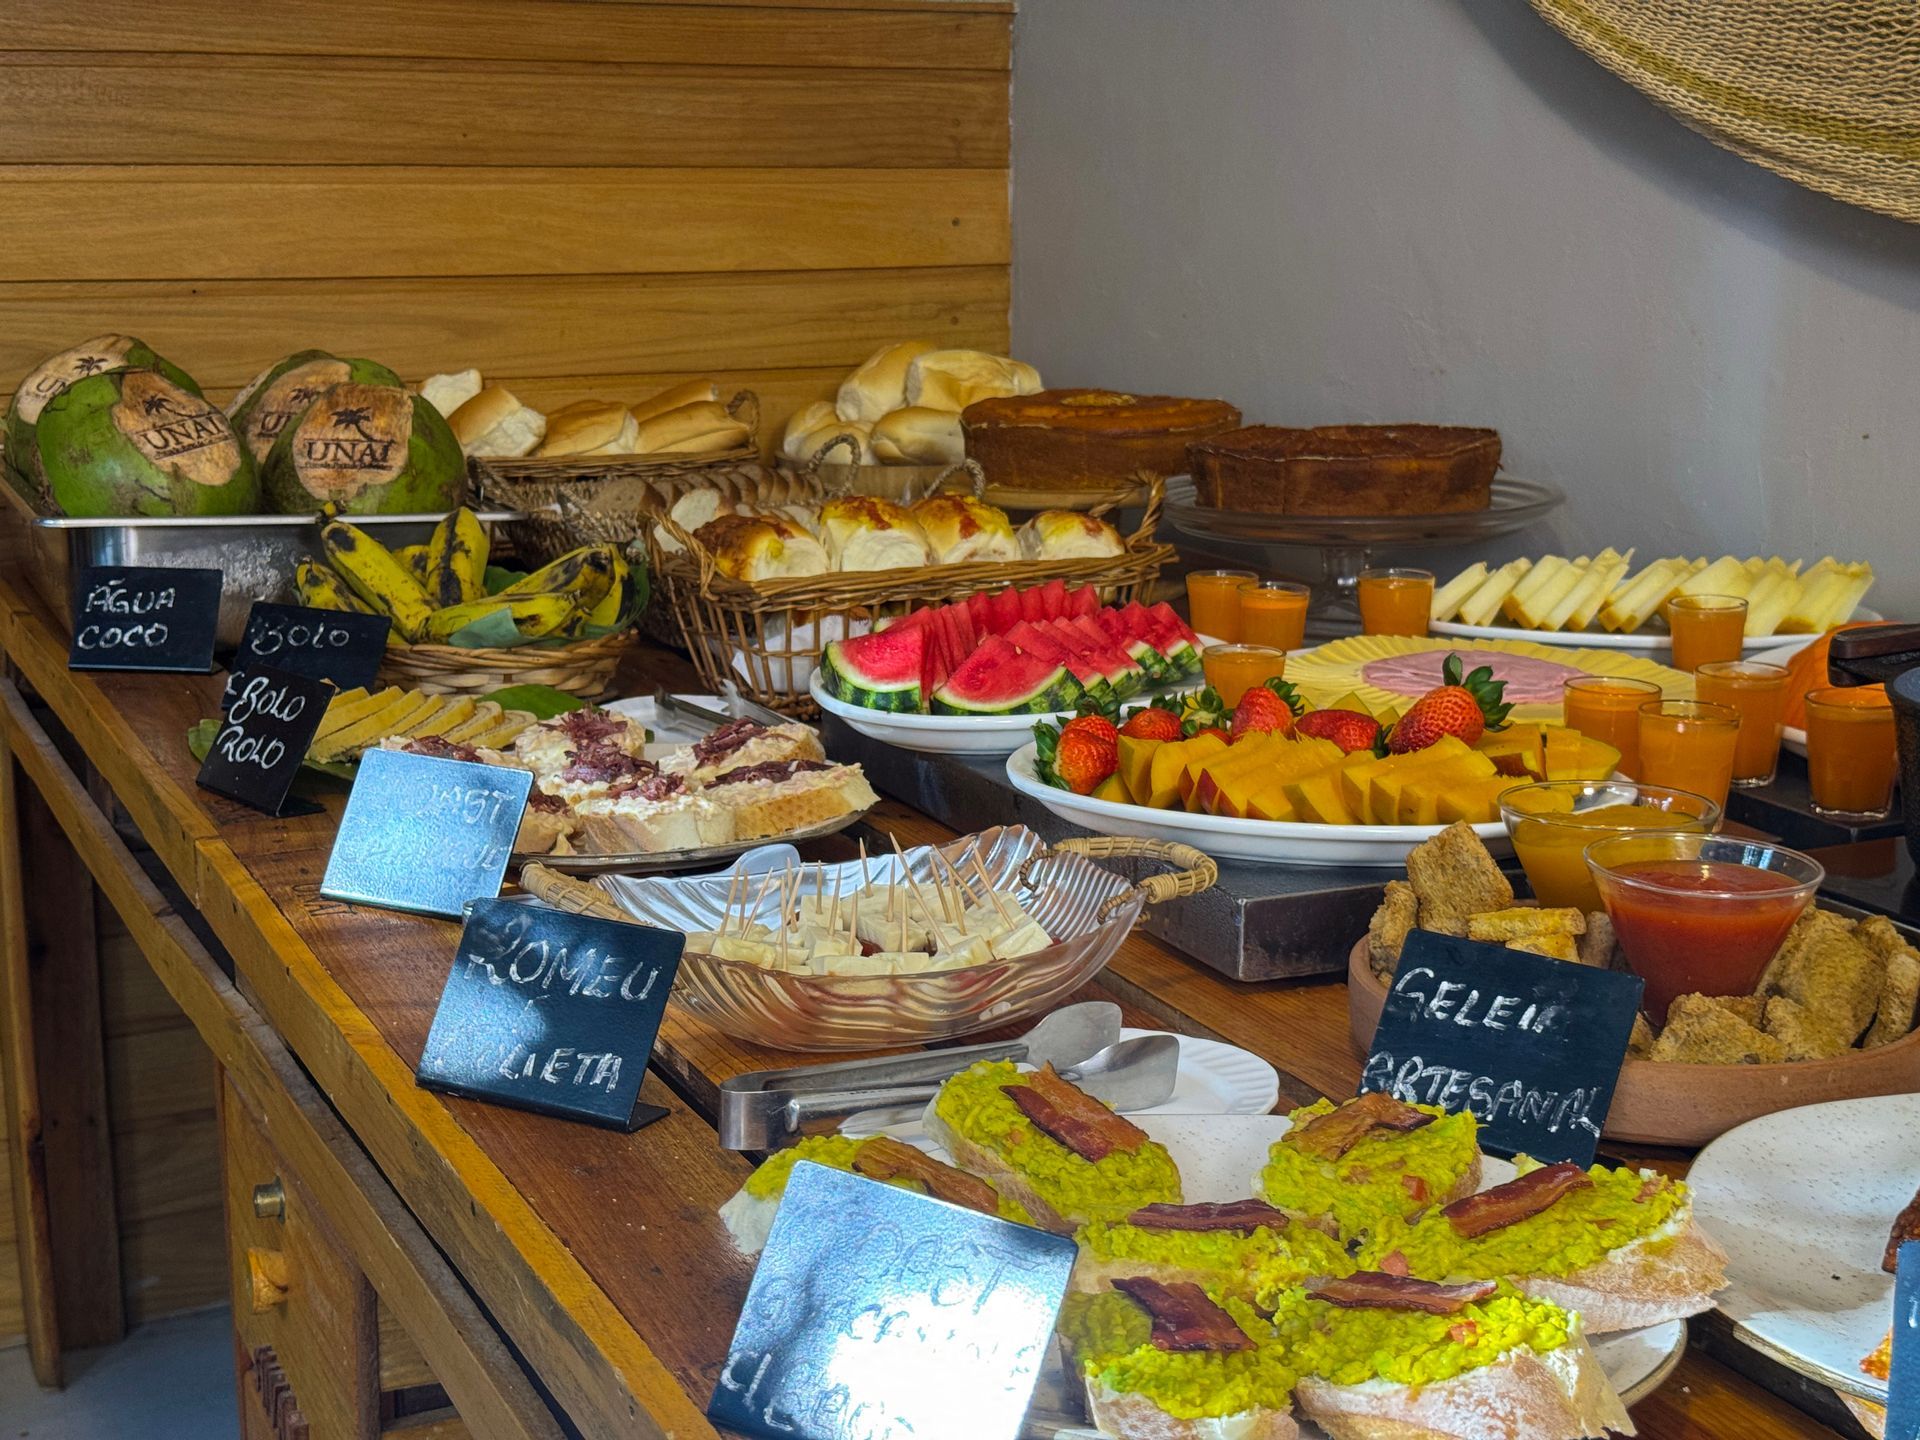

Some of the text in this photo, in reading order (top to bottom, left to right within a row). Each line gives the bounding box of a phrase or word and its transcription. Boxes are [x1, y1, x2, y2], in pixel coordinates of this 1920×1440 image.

[77, 622, 169, 650] COCO
[229, 676, 306, 724] BOLO
[216, 725, 286, 770] ROLO
[463, 914, 663, 1001] ROMEU
